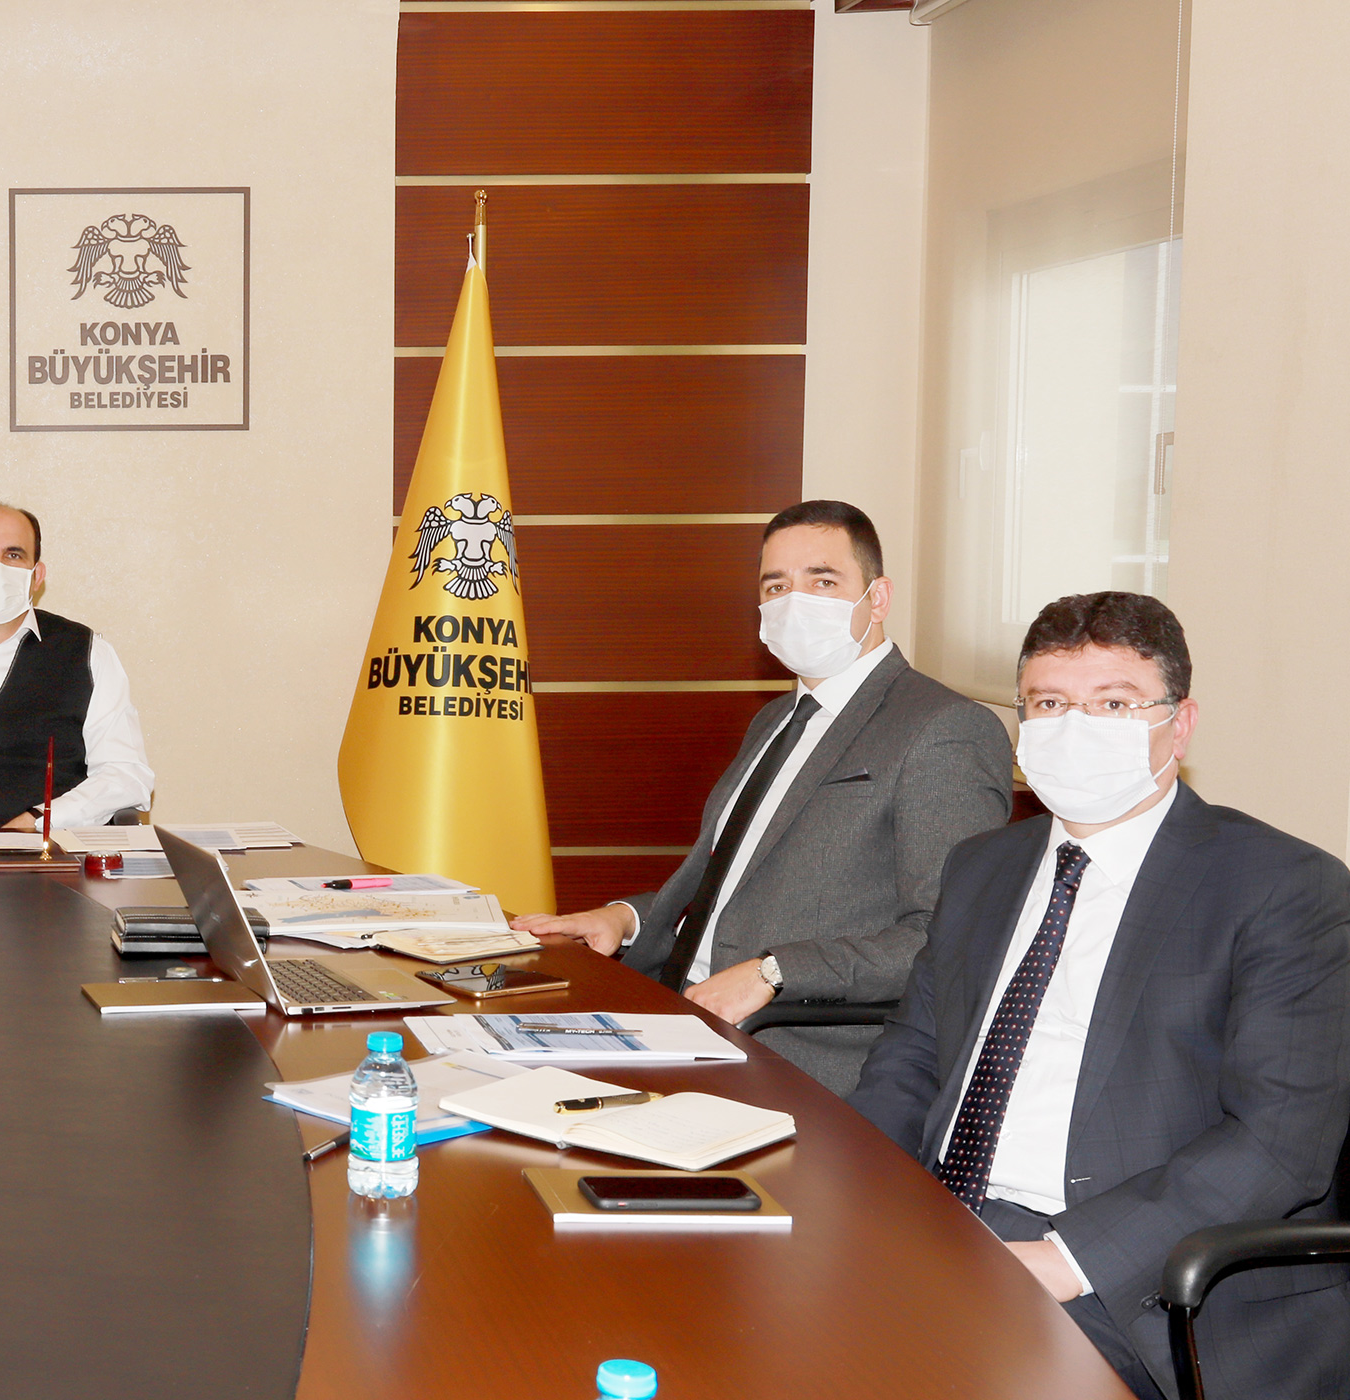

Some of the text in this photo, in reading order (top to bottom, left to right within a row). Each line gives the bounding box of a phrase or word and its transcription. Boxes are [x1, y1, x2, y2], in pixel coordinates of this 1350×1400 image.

[79, 321, 180, 346] KONYA
[27, 347, 231, 390] BÜYÜKŞEHİR
[69, 391, 189, 408] BELEDİYESİ
[413, 615, 518, 648] KONYA
[398, 692, 524, 721] BELEDİYESİ
